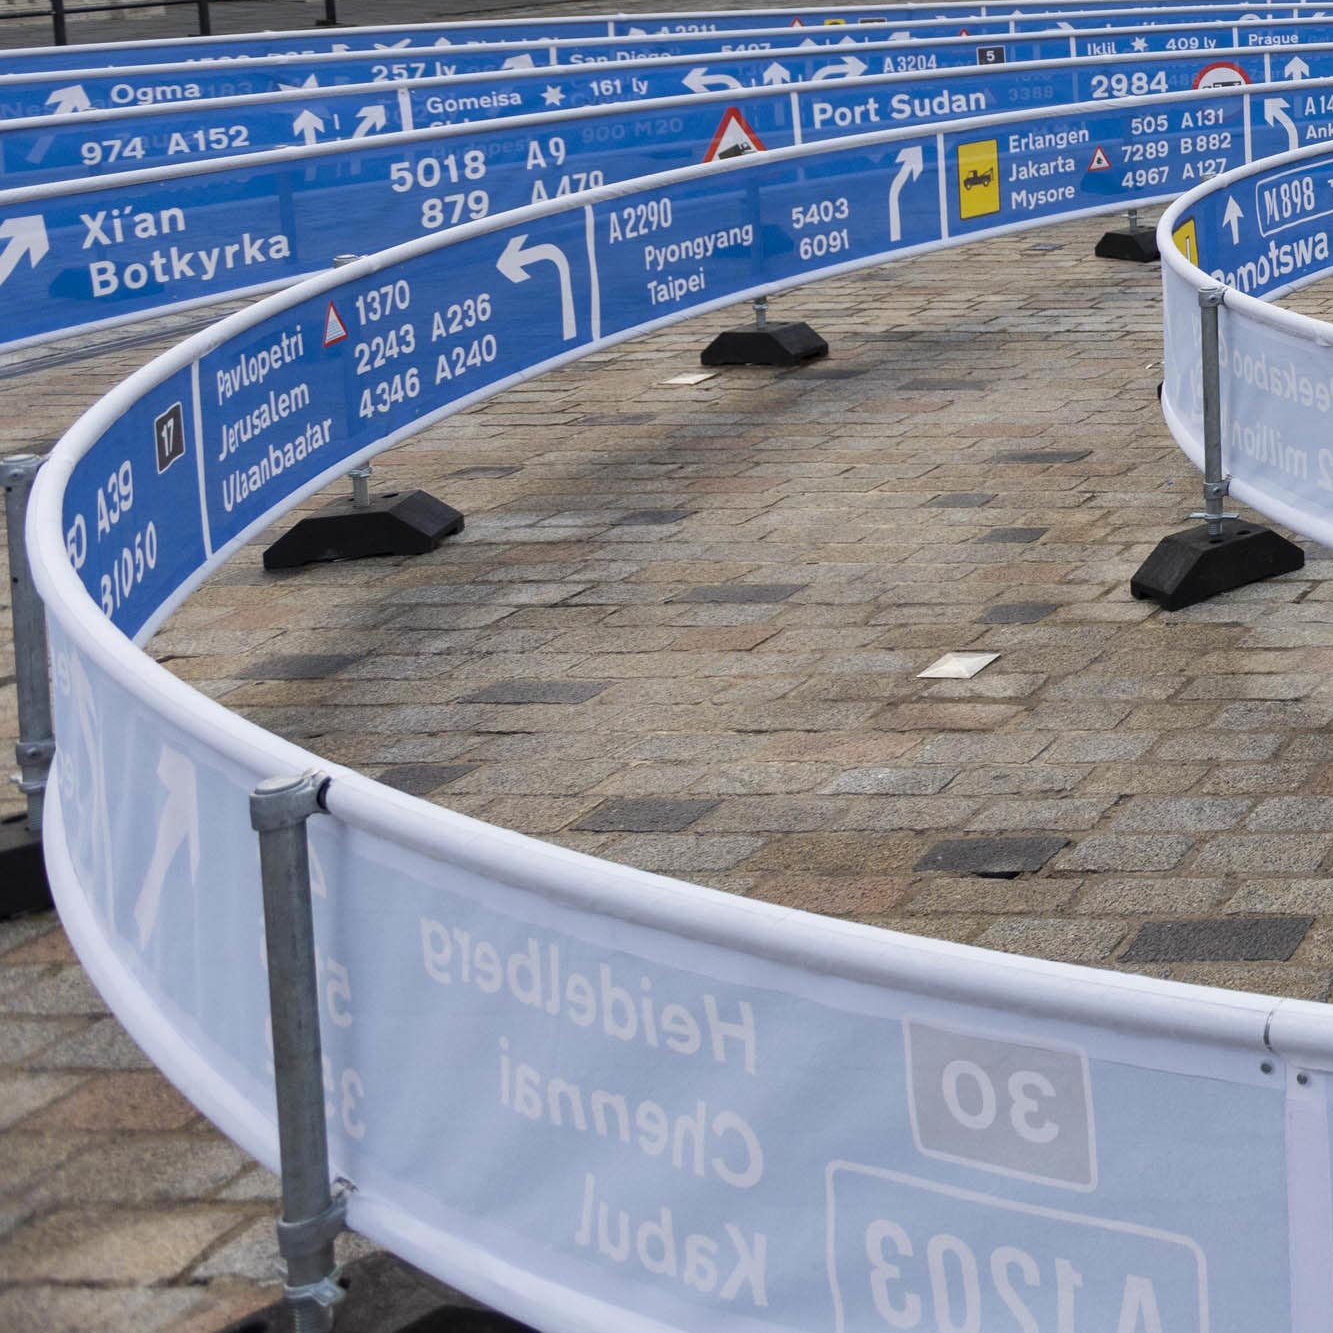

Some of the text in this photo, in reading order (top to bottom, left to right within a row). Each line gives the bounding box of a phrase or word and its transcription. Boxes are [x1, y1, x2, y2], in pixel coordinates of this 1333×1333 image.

[986, 51, 995, 62] 5
[1087, 37, 1200, 55] Iklil 409
[1248, 33, 1299, 45] Prague
[370, 62, 425, 82] 257
[883, 54, 937, 73] A3204
[1091, 71, 1168, 97] 2984
[110, 83, 201, 105] Ogma
[426, 92, 522, 114] Gomeisa
[589, 77, 649, 97] 161 ly
[813, 90, 986, 129] Port Sudan
[1008, 108, 1224, 153] Erlangen 505 A131
[81, 125, 250, 166] 974 A152
[1008, 132, 1231, 182] Jakarta 7289 B882
[390, 150, 487, 193] 5018
[1012, 185, 1075, 210] Mysore
[1121, 166, 1169, 188] 4967
[421, 190, 490, 229] 879
[609, 198, 673, 244] A2290
[1263, 176, 1314, 226] M898
[645, 198, 850, 270] Pyongyang 5403
[89, 233, 290, 298] Botkyrka
[647, 229, 849, 305] Taipei 6091
[217, 281, 411, 405] Pavlopetri 1370
[218, 294, 491, 462] Jerusalem 2243 A236
[161, 415, 174, 459] 17
[222, 334, 497, 512] Ulaanbaatar 4346 A240
[97, 460, 134, 542] A39
